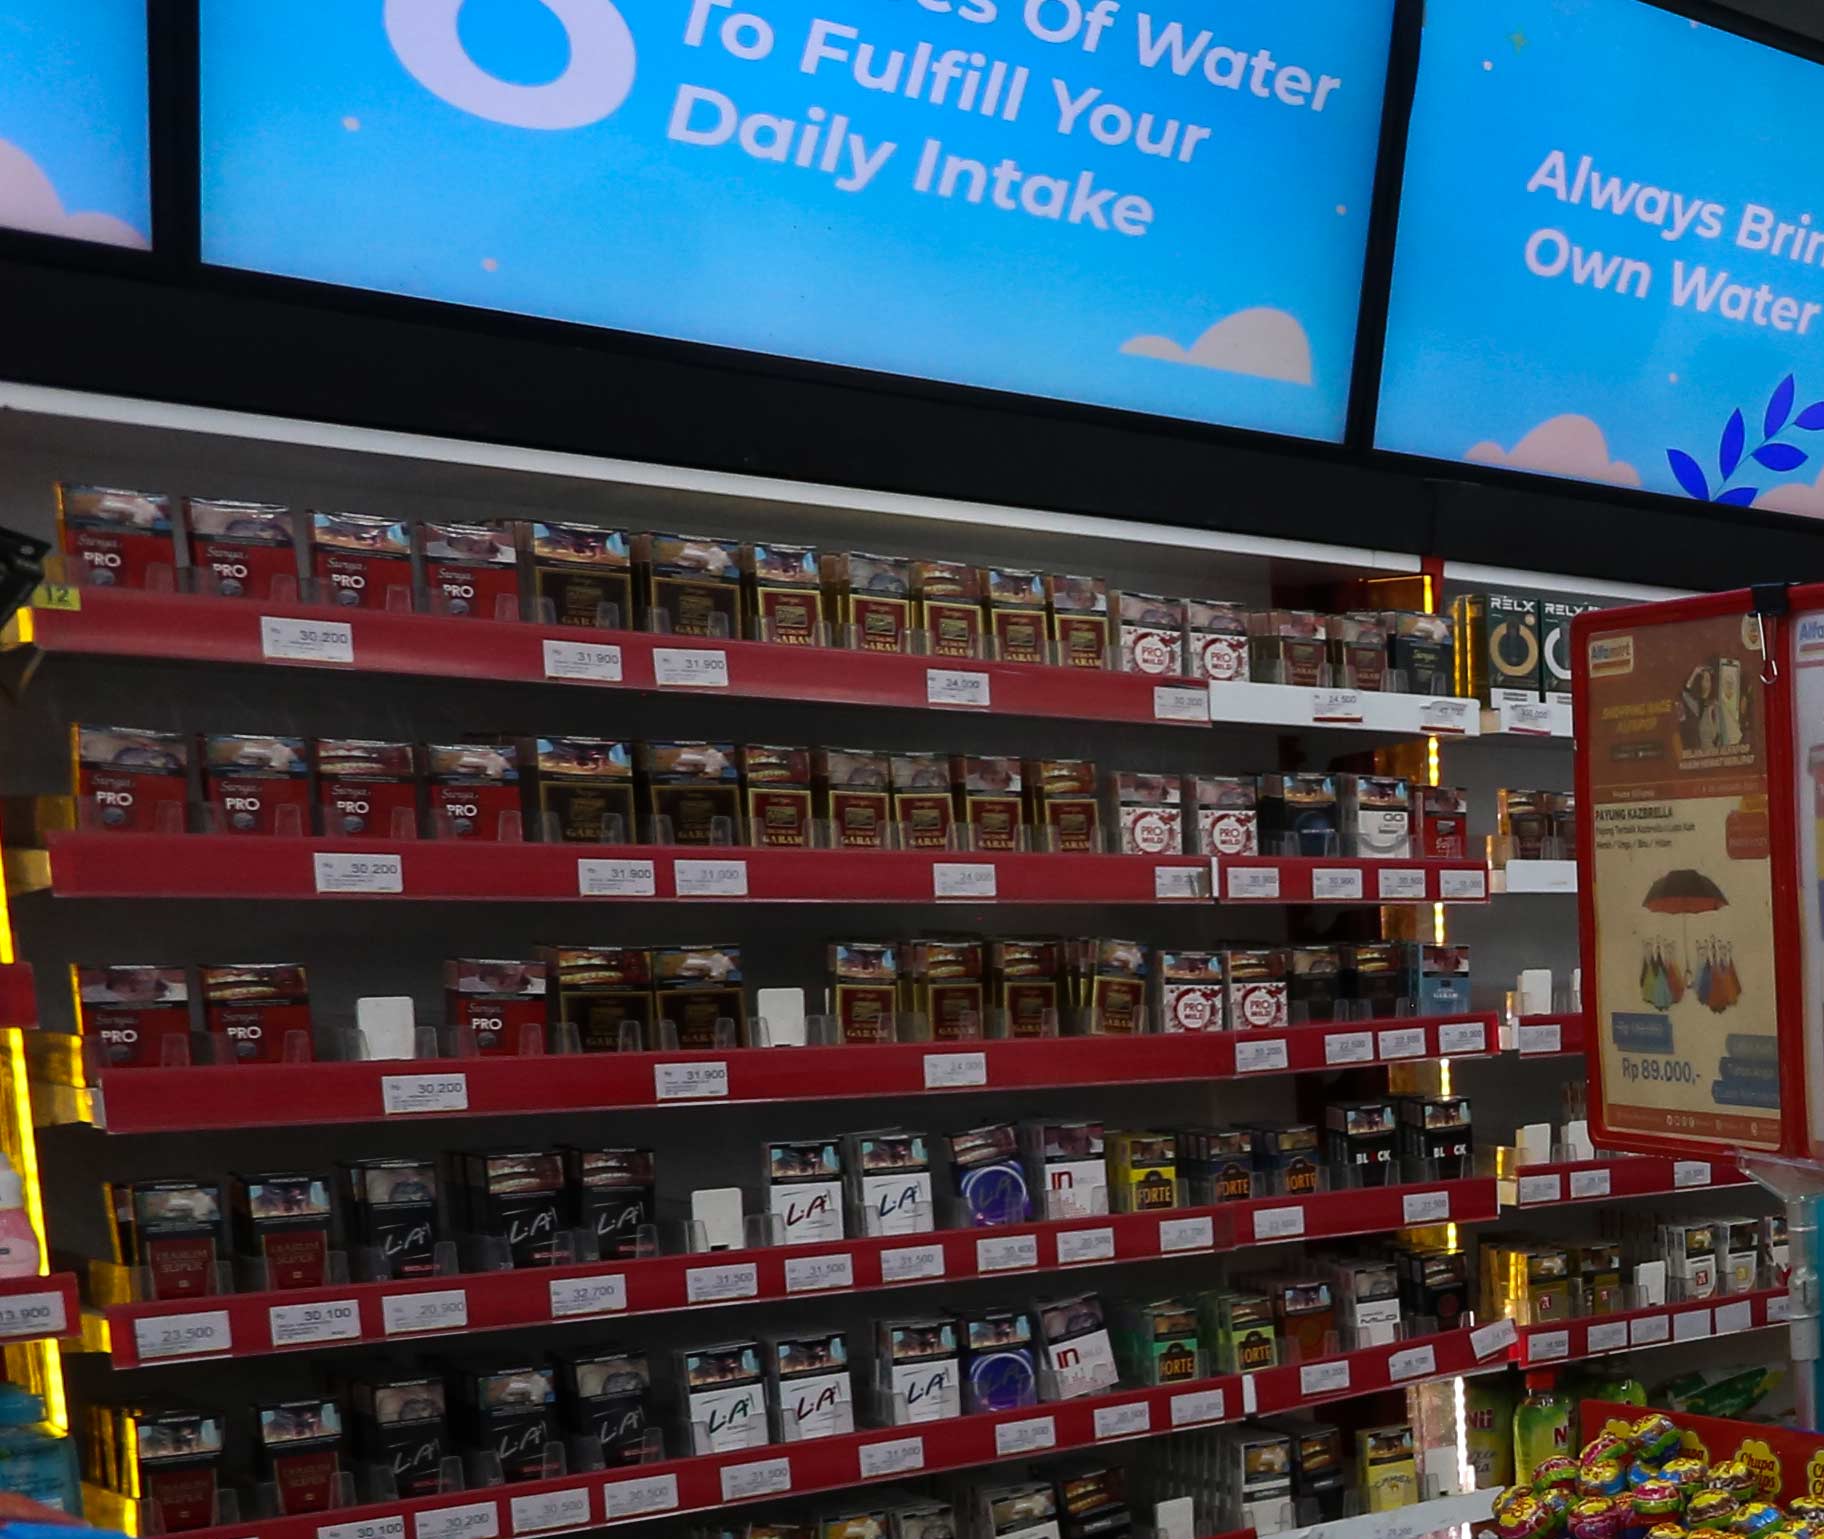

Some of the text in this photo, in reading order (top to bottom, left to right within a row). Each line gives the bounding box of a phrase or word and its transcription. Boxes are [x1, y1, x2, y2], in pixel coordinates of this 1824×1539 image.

[1023, 0, 1342, 113] Of Water
[682, 0, 1212, 163] To Fulfill Your
[667, 83, 1154, 238] Daily Intake
[1525, 149, 1724, 242] Always
[1524, 227, 1651, 301] Own
[1669, 258, 1817, 337] Water
[83, 551, 121, 568] PRO
[213, 563, 248, 579] PRO
[332, 573, 365, 590] PRO
[442, 582, 475, 599] PRO
[1490, 597, 1535, 613] RELX
[1544, 603, 1584, 617] RELX
[97, 791, 133, 806] PRO
[225, 796, 260, 812] PRO
[338, 800, 370, 815] PRO
[1622, 1058, 1640, 1081] Rp
[1740, 1448, 1775, 1473] Chupa
